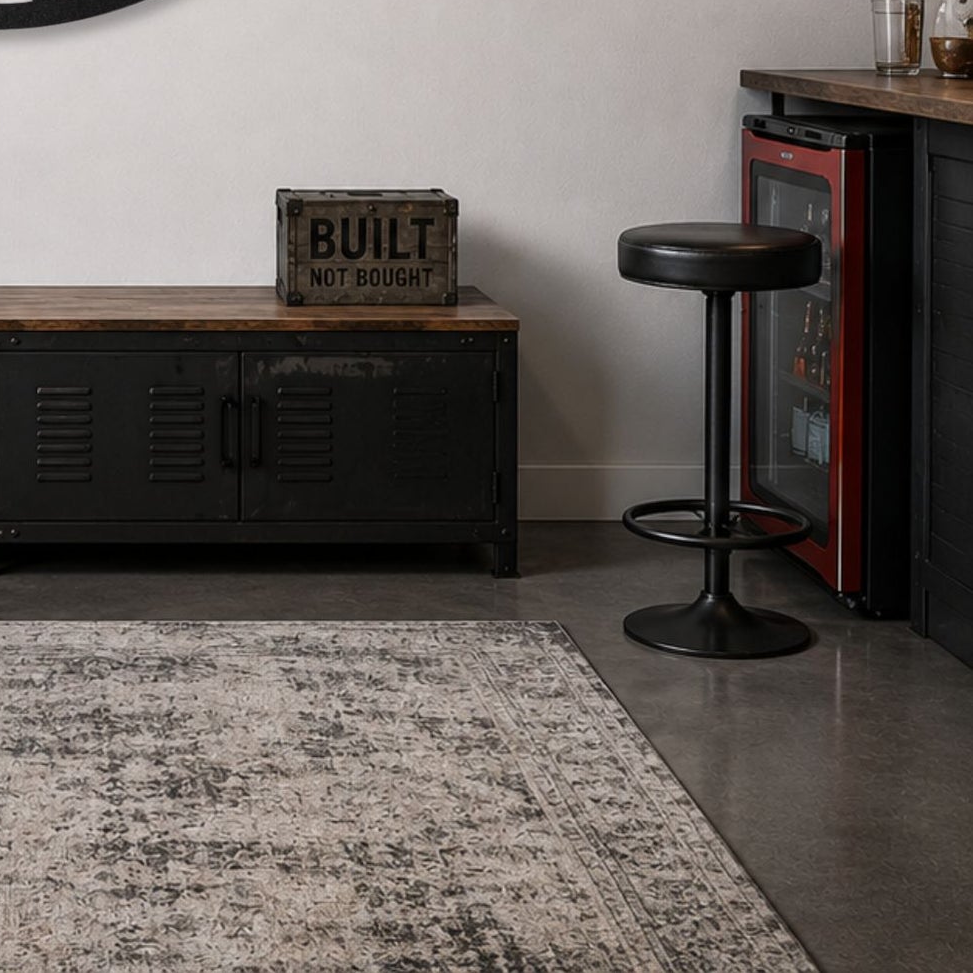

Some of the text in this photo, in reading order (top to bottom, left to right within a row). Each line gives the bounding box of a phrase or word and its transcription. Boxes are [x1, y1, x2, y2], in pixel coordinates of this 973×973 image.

[310, 217, 435, 260] BUILT
[310, 267, 433, 287] NOT BOUGHT
